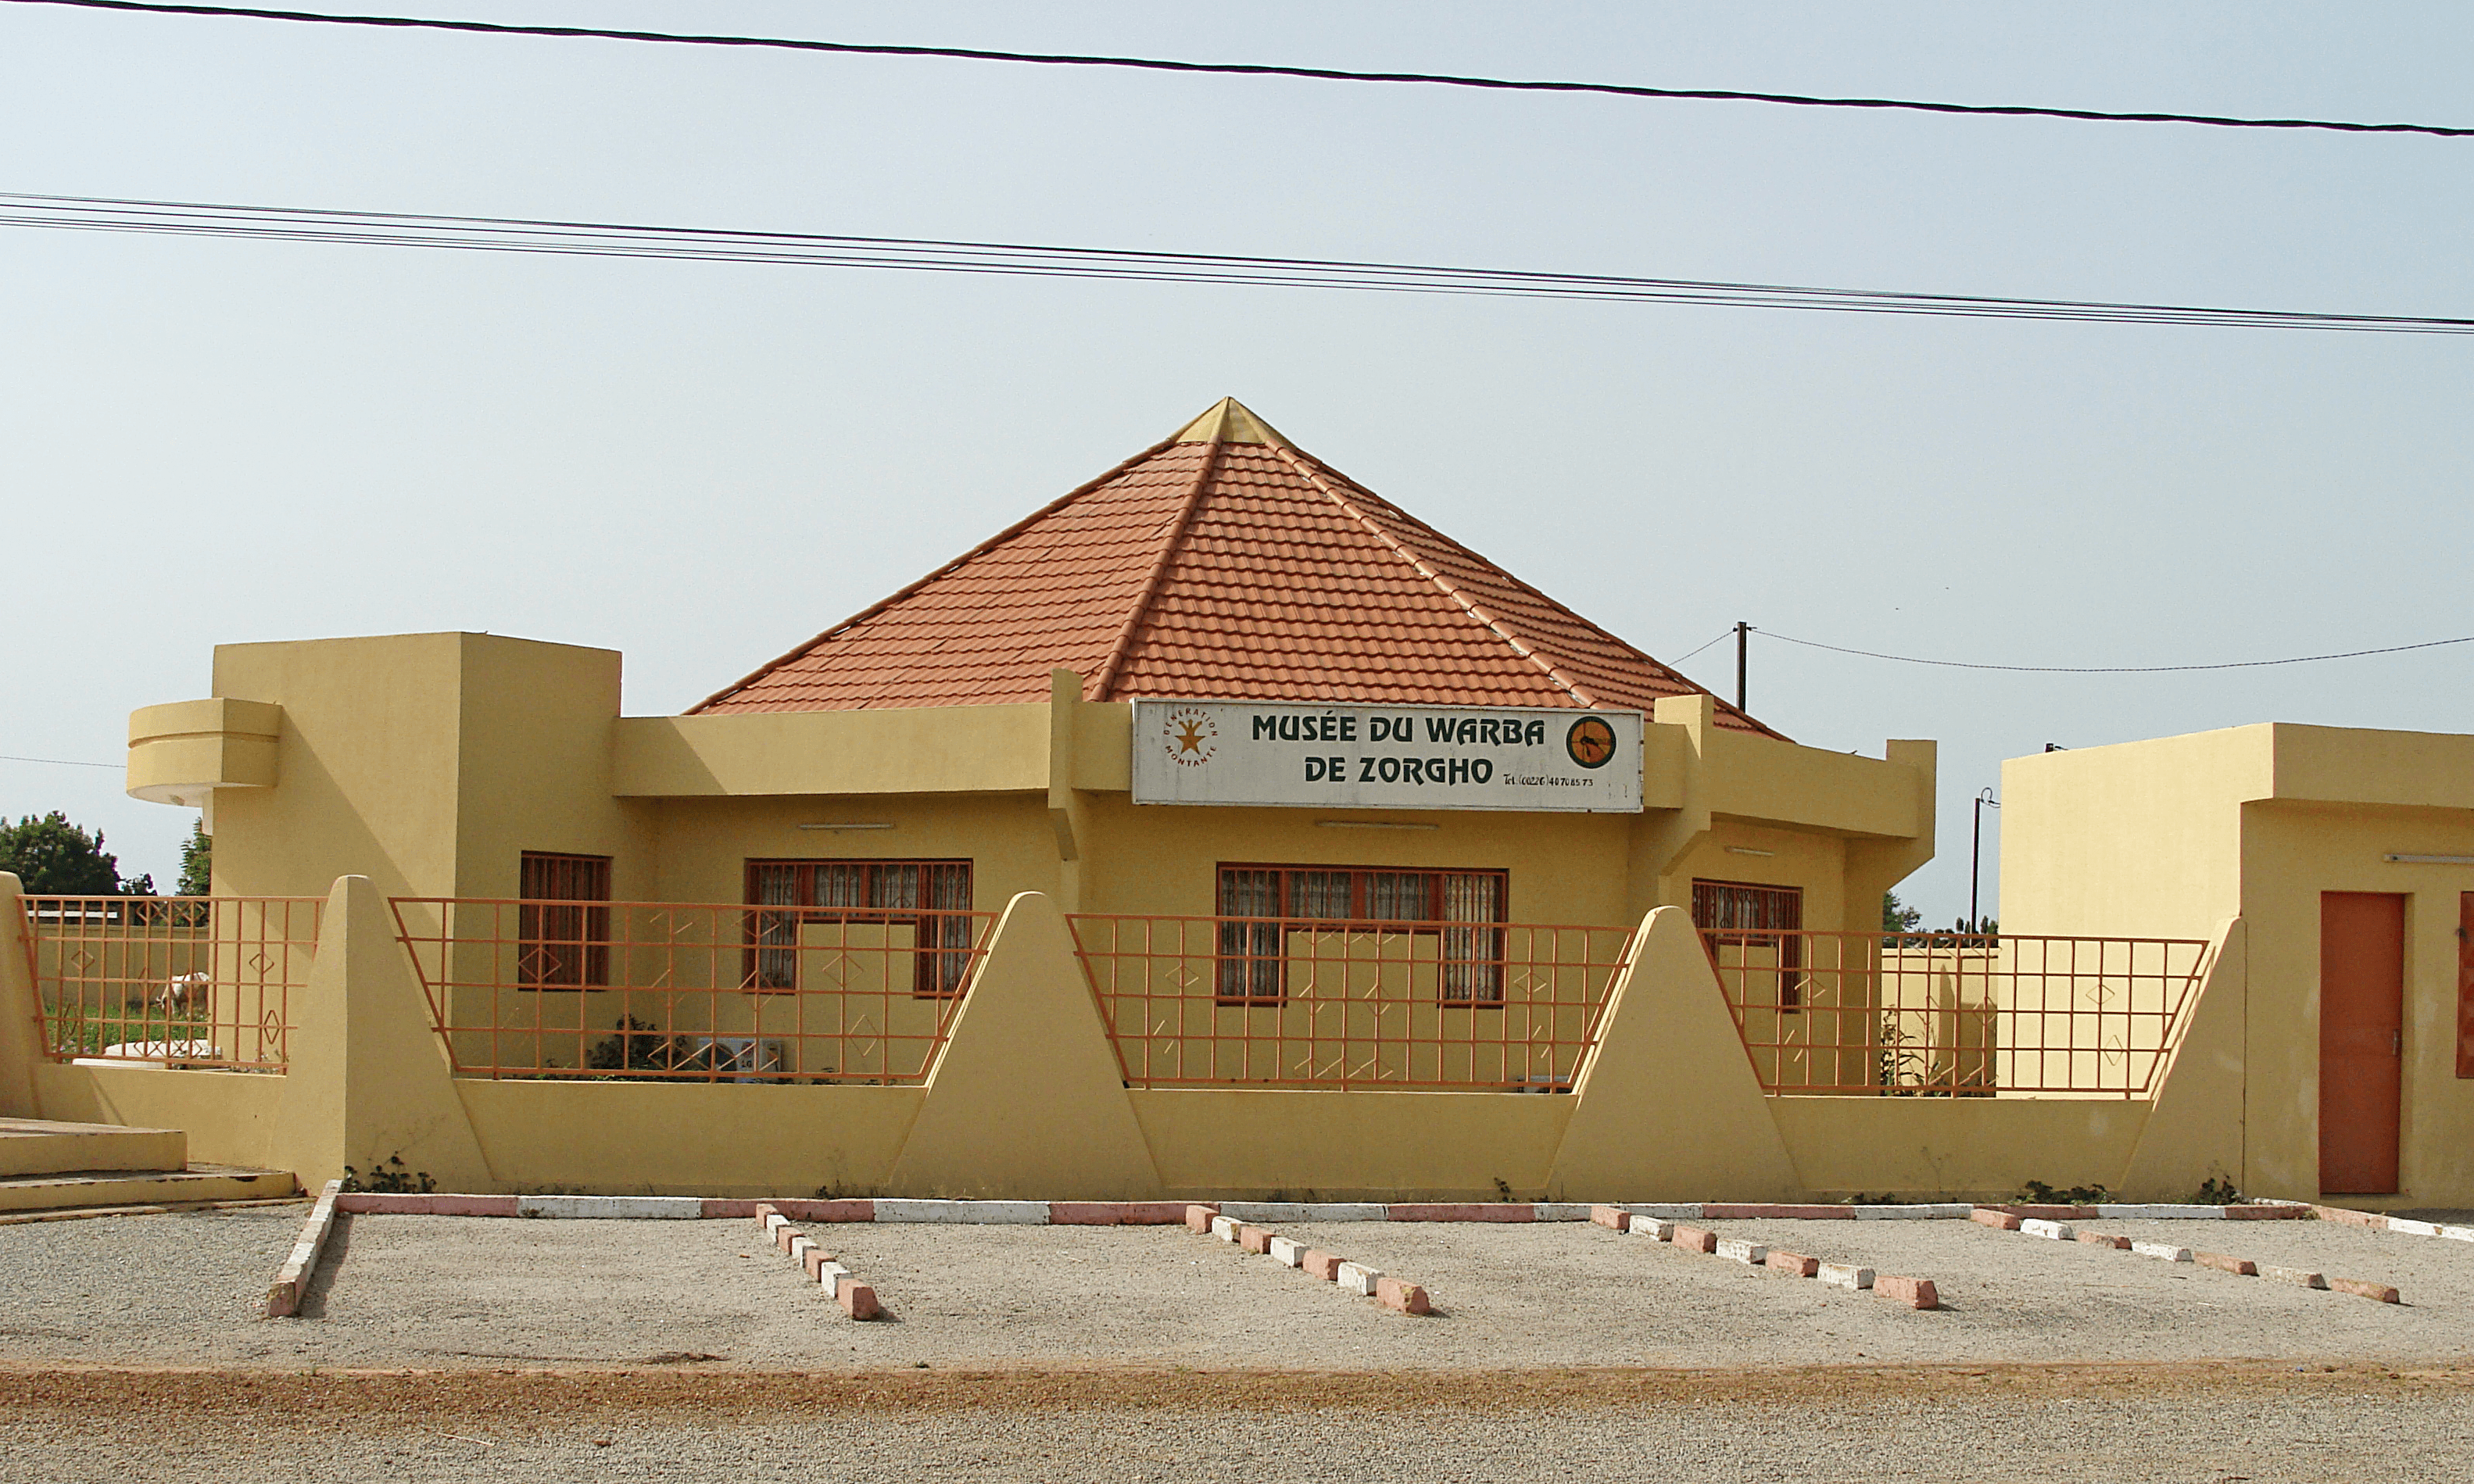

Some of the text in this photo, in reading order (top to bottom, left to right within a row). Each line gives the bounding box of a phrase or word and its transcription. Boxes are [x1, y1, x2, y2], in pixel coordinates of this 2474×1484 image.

[1252, 710, 1545, 747] MUSÉE DU WARBA
[1165, 745, 1217, 767] MONTANTE
[1305, 756, 1493, 786] DE ZORGHO
